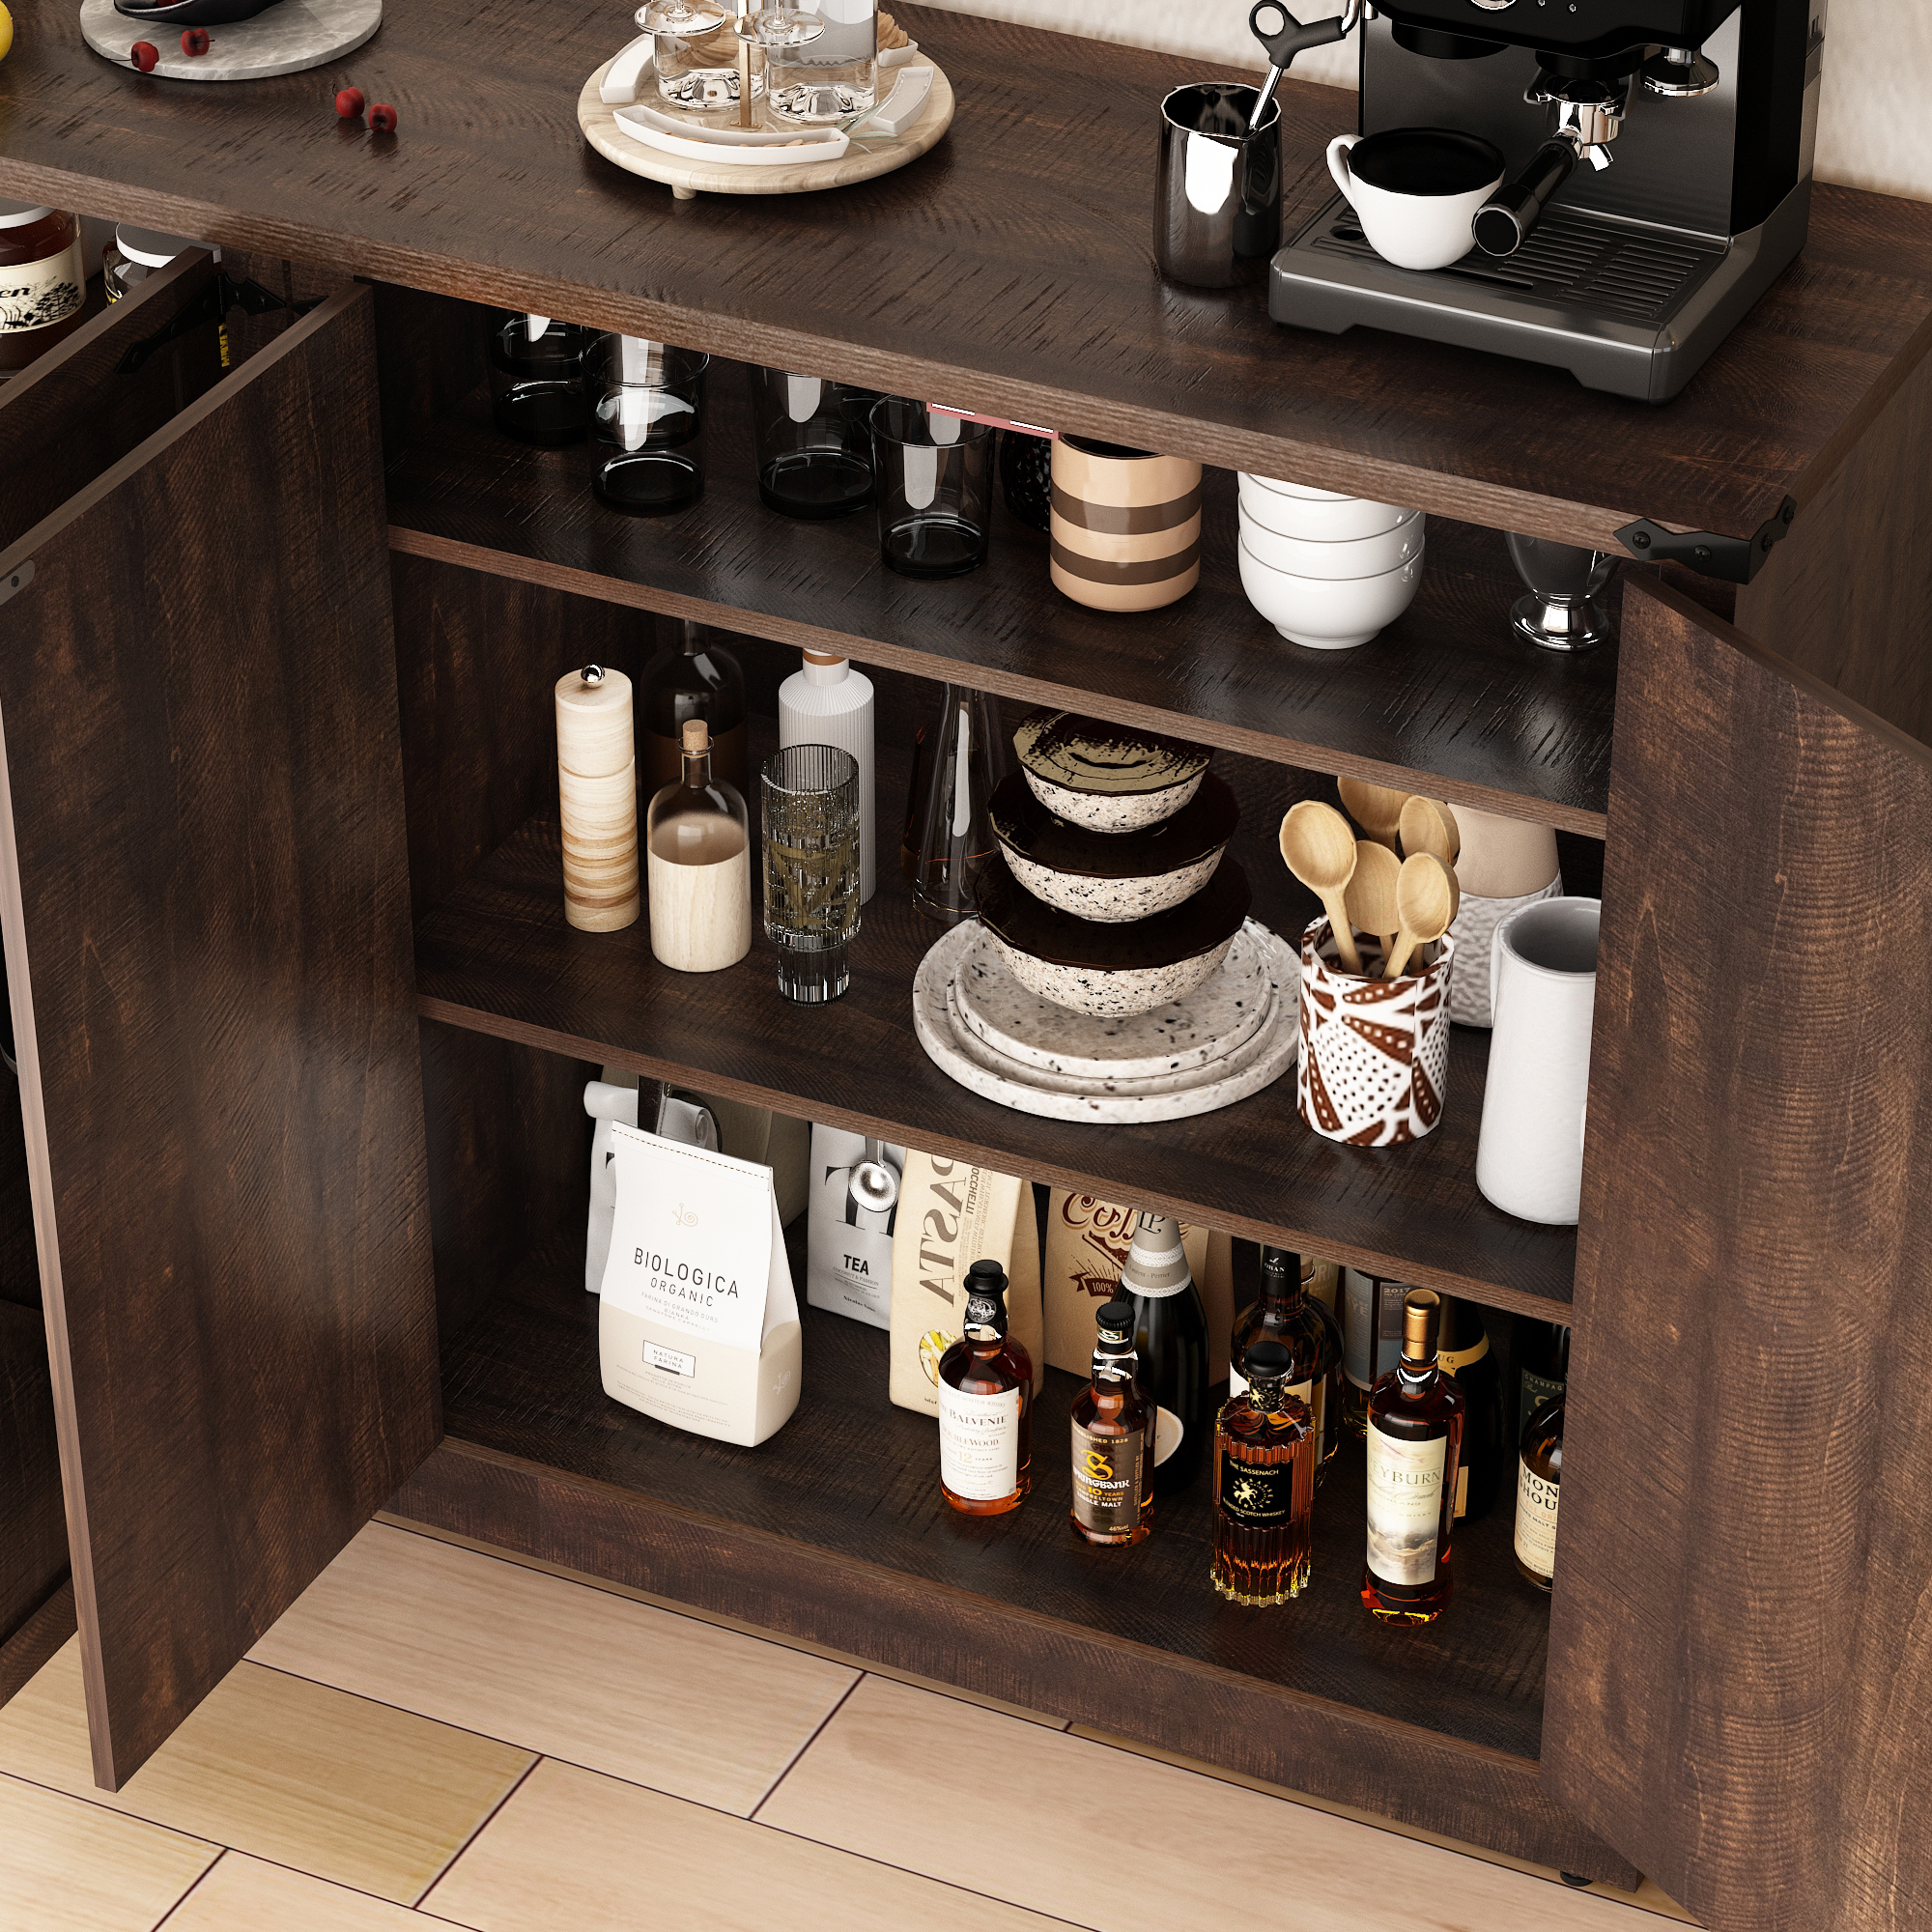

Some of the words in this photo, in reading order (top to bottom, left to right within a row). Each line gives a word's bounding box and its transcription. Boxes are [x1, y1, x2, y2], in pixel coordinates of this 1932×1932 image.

[0, 288, 30, 298] en
[634, 1247, 738, 1299] BIOLOGICA
[843, 1254, 869, 1275] TEA
[651, 1277, 714, 1307] ORGANIC
[1092, 1282, 1114, 1294] 100%
[641, 1292, 662, 1304] FARINA
[671, 1304, 699, 1318] GRANDO
[700, 1313, 719, 1323] DURO
[653, 1350, 684, 1363] NATURA
[653, 1355, 683, 1369] FARINA
[1437, 1354, 1455, 1364] UG
[1524, 1373, 1563, 1391] CHAMPAG
[950, 1408, 1007, 1426] BALVENIE
[958, 1450, 973, 1464] 12
[1081, 1448, 1114, 1481] S
[1229, 1459, 1239, 1470] THE
[1239, 1466, 1279, 1476] SASSENACH
[1370, 1457, 1441, 1486] EYBURN
[1522, 1464, 1558, 1498] MON
[1088, 1486, 1102, 1496] 10
[1520, 1477, 1557, 1511] SHOU
[1239, 1508, 1262, 1518] SCOTCH
[1541, 1508, 1556, 1521] ORI
